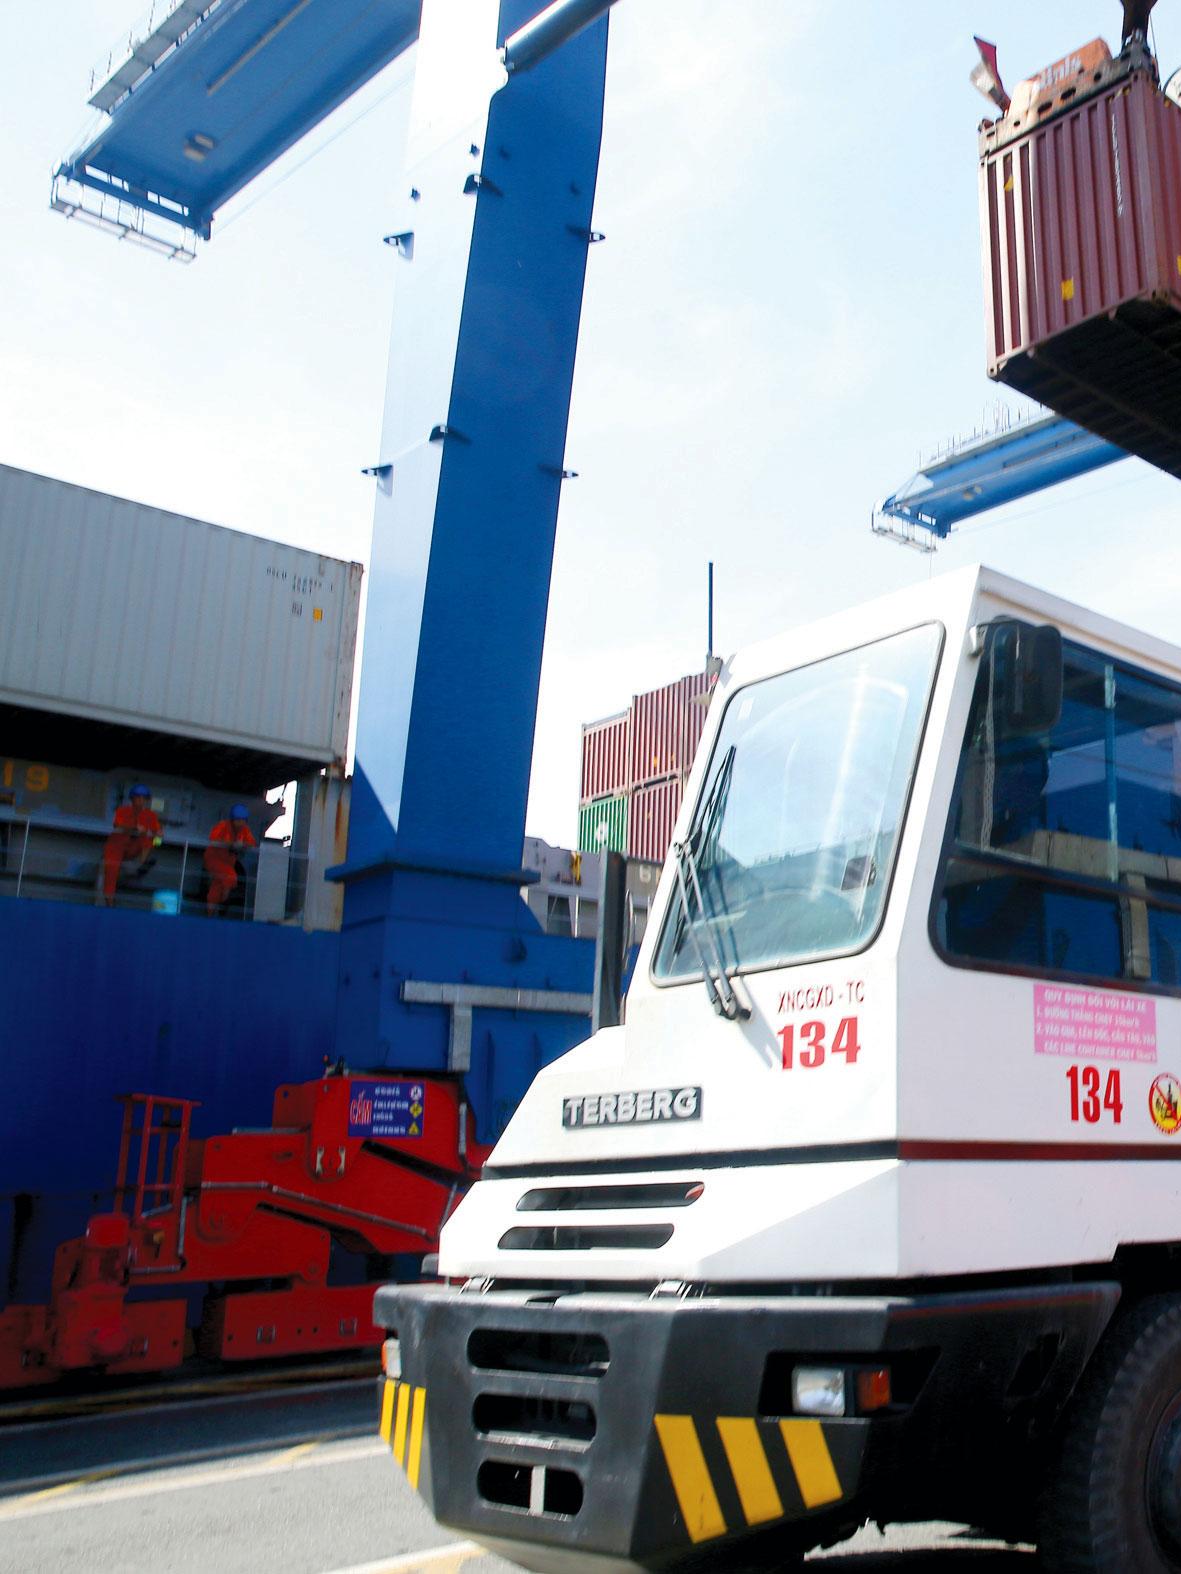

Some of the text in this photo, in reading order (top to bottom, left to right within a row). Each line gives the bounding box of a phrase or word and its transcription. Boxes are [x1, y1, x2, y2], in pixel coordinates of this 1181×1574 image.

[846, 980, 865, 1003] TC
[777, 1016, 861, 1070] 134
[564, 1087, 698, 1126] TERBERG
[1066, 1064, 1123, 1124] 134
